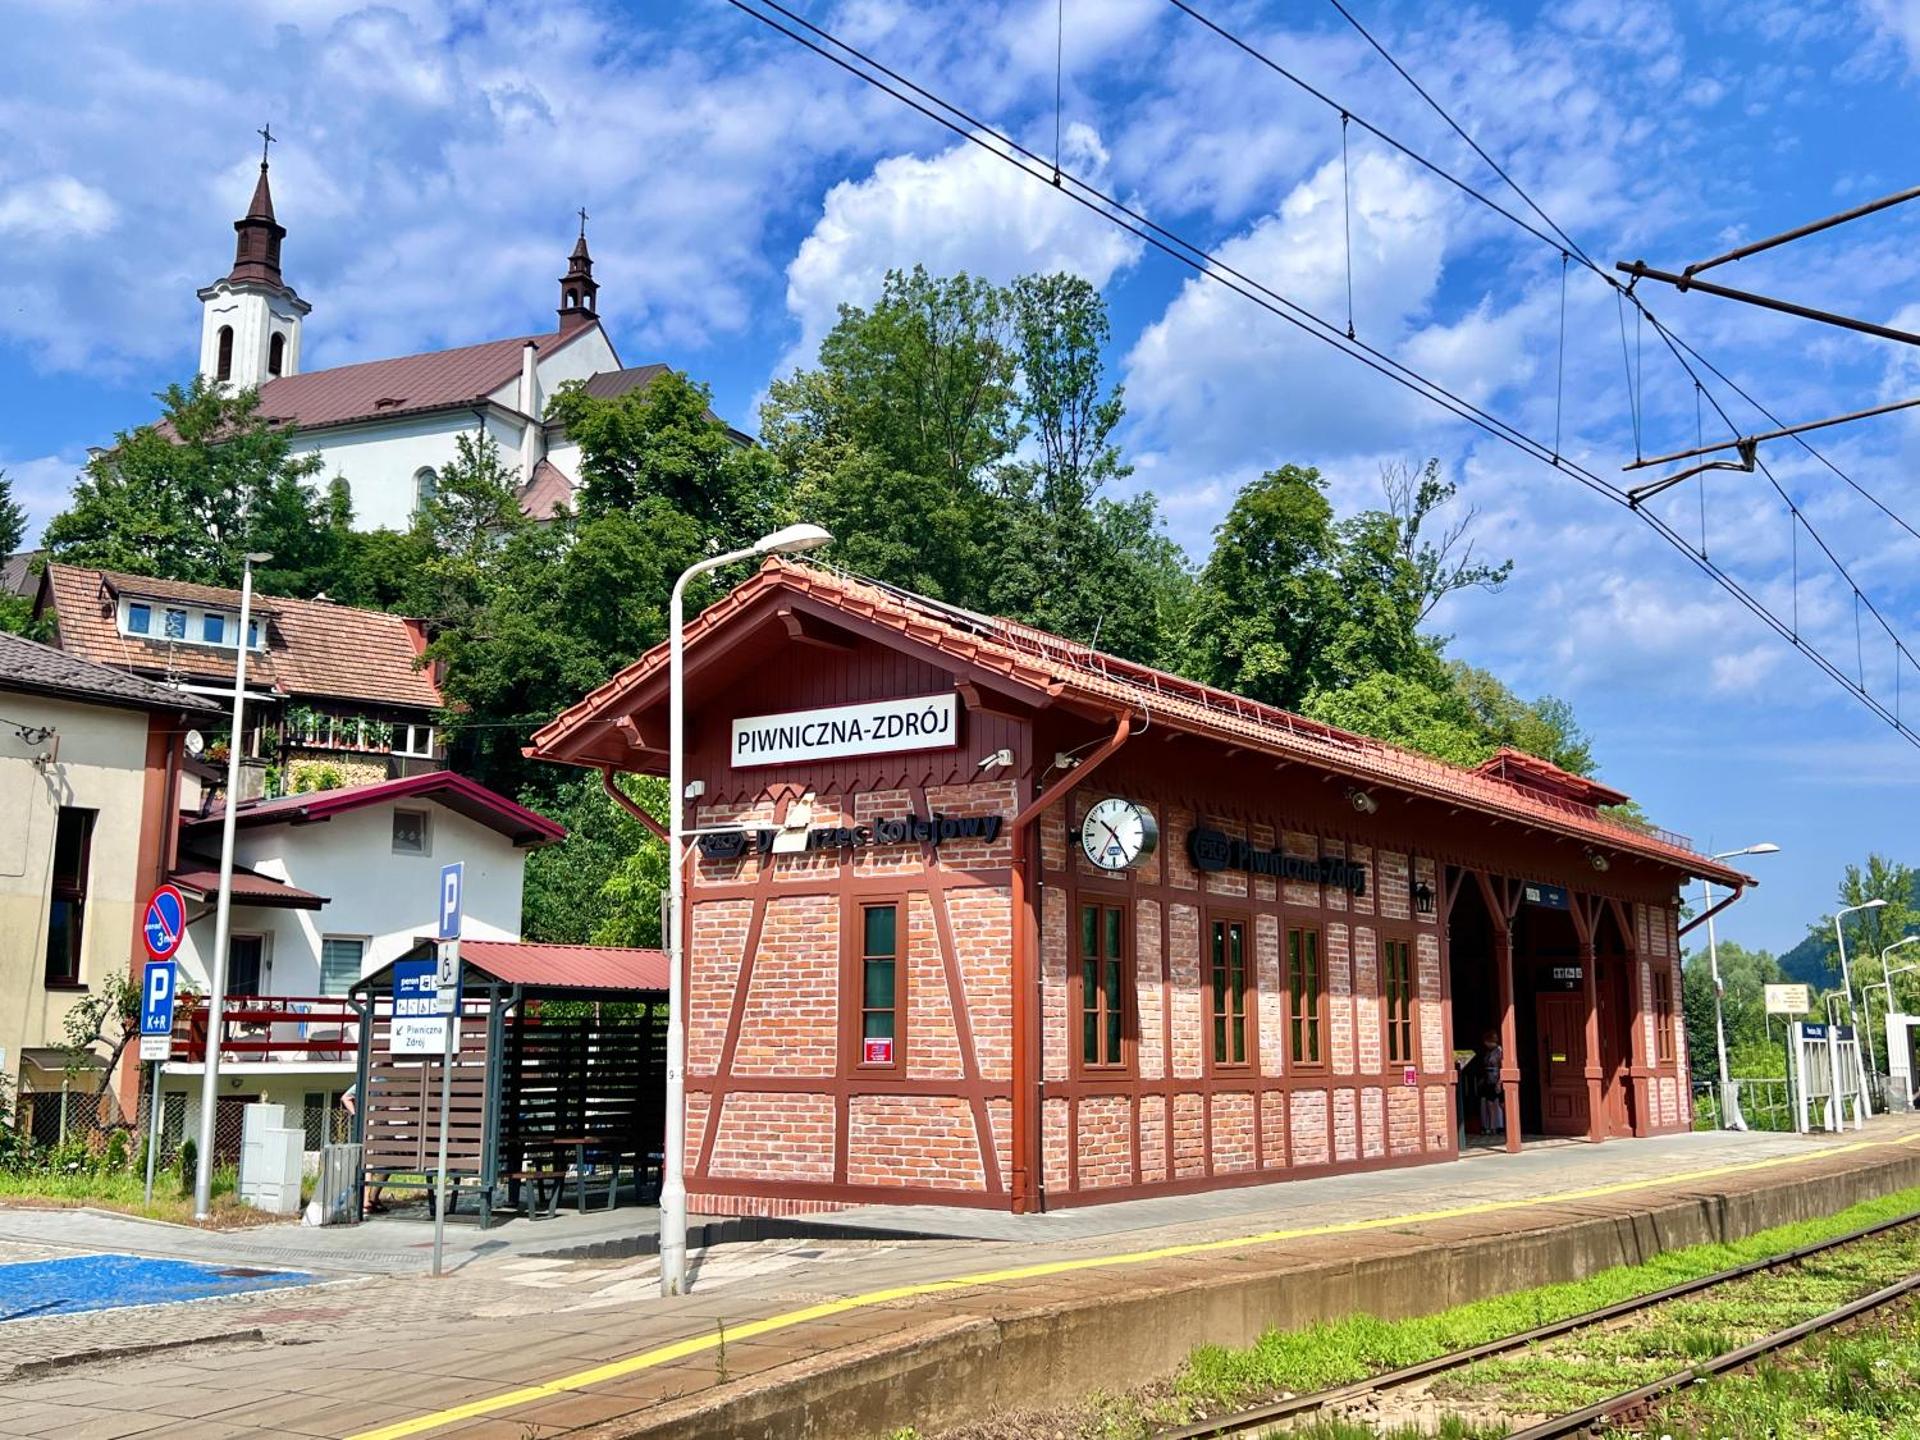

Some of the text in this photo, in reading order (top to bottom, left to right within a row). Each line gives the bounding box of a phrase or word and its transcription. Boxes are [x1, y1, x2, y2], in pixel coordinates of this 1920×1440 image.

[738, 705, 949, 754] PIWNICZNA-ZDRÓJ
[756, 824, 863, 851] Drzec
[873, 814, 1000, 847] kolejowy
[1200, 840, 1227, 860] PKP
[443, 872, 458, 931] P
[157, 932, 164, 946] 3
[149, 968, 169, 1013] P
[147, 1014, 166, 1030] K+R
[407, 1025, 442, 1034] Piwniczna
